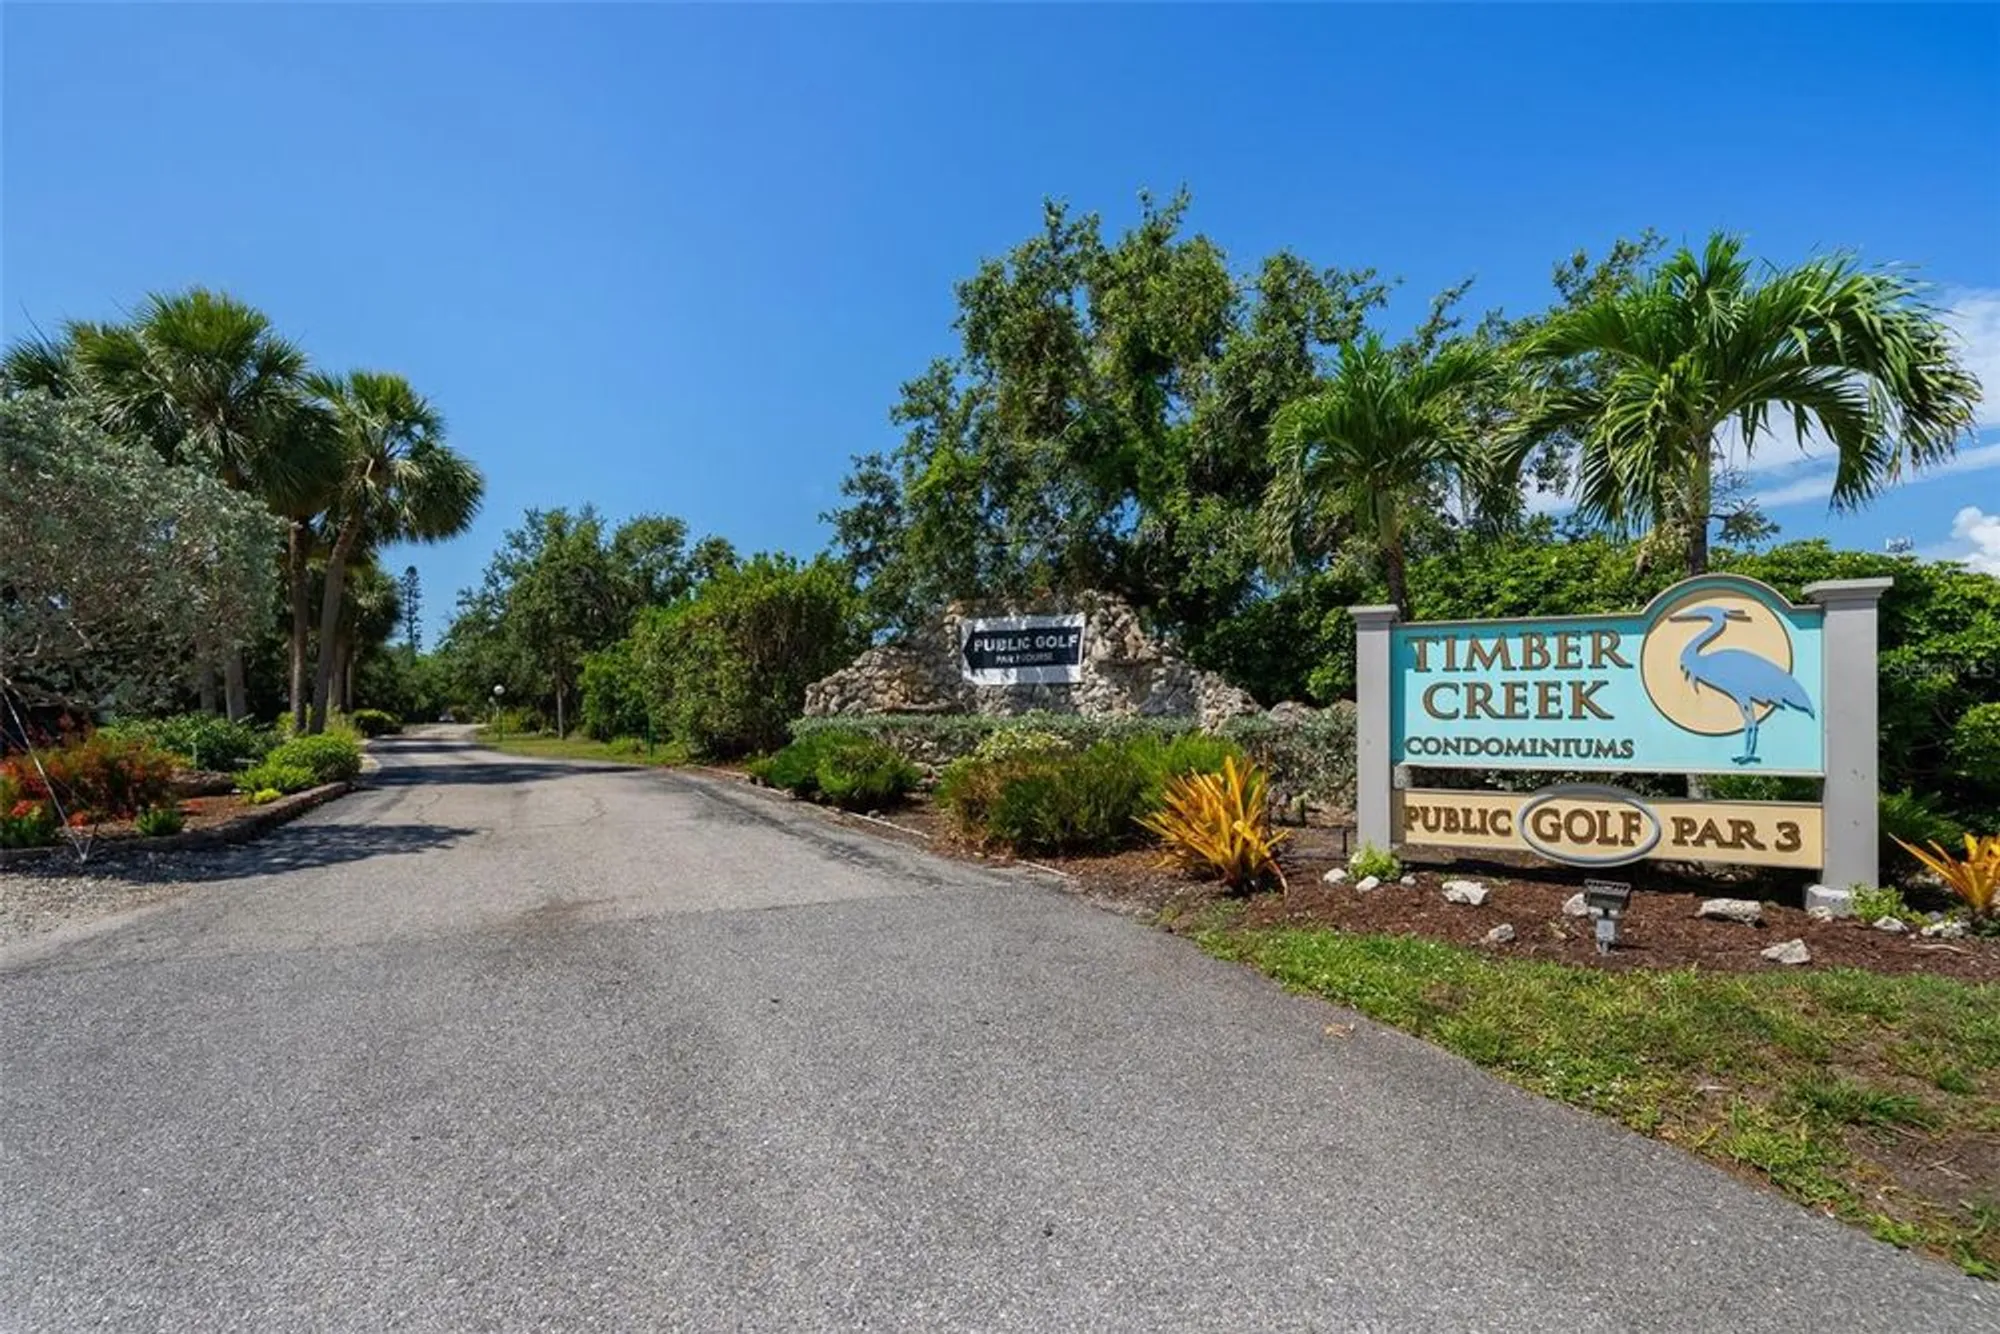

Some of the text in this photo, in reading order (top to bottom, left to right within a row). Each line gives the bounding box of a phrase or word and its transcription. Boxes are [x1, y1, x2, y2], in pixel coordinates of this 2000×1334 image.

[974, 634, 1079, 652] PUBLIC GOLF
[1406, 629, 1634, 673] TIMBER
[1422, 680, 1615, 720] CREEK
[1404, 736, 1635, 759] CONDOMINIUMS
[1403, 805, 1802, 852] PUBLIC GOLF PAR 3
